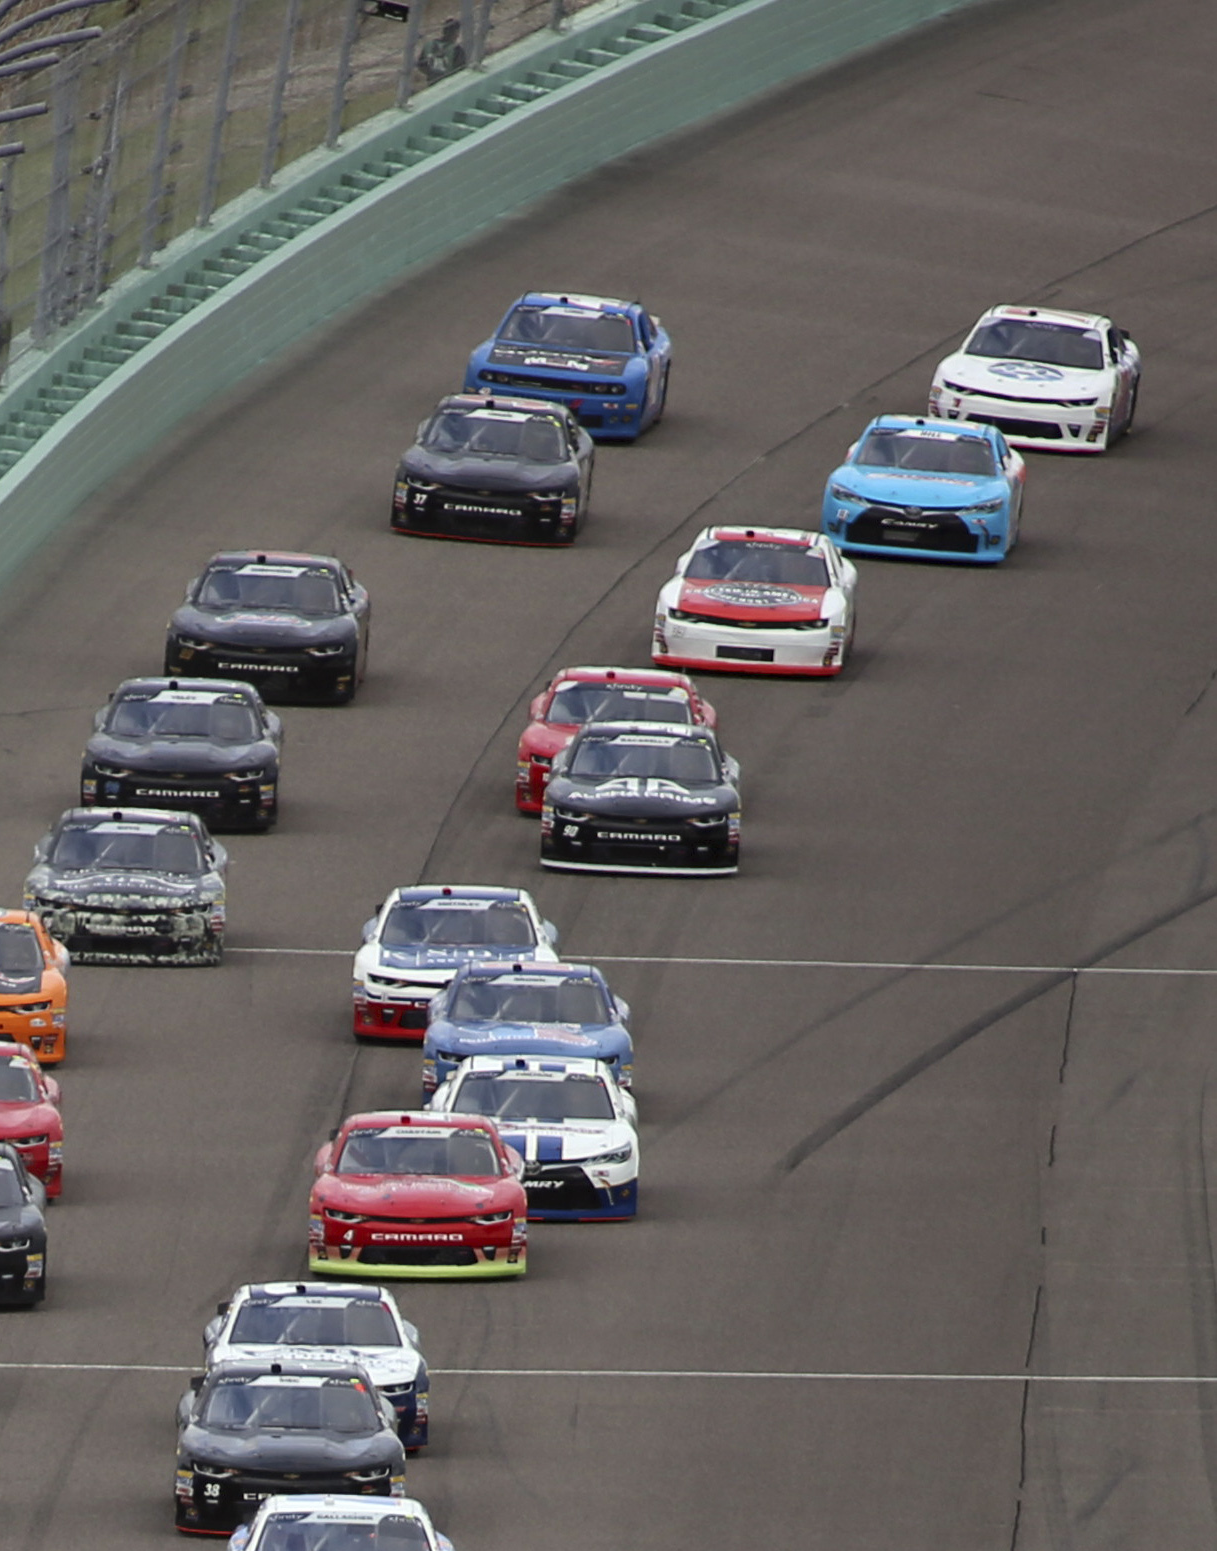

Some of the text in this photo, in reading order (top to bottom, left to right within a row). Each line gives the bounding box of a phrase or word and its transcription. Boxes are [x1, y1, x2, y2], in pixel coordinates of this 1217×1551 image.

[413, 493, 427, 504] 37
[443, 503, 522, 516] CAMARO
[218, 662, 299, 672] CAMARO
[135, 788, 220, 797] CAMARO
[597, 831, 681, 841] CAMARO
[524, 1180, 564, 1188] MRY
[343, 1229, 353, 1241] 4
[371, 1232, 463, 1242] CAMARO
[204, 1484, 220, 1497] 38
